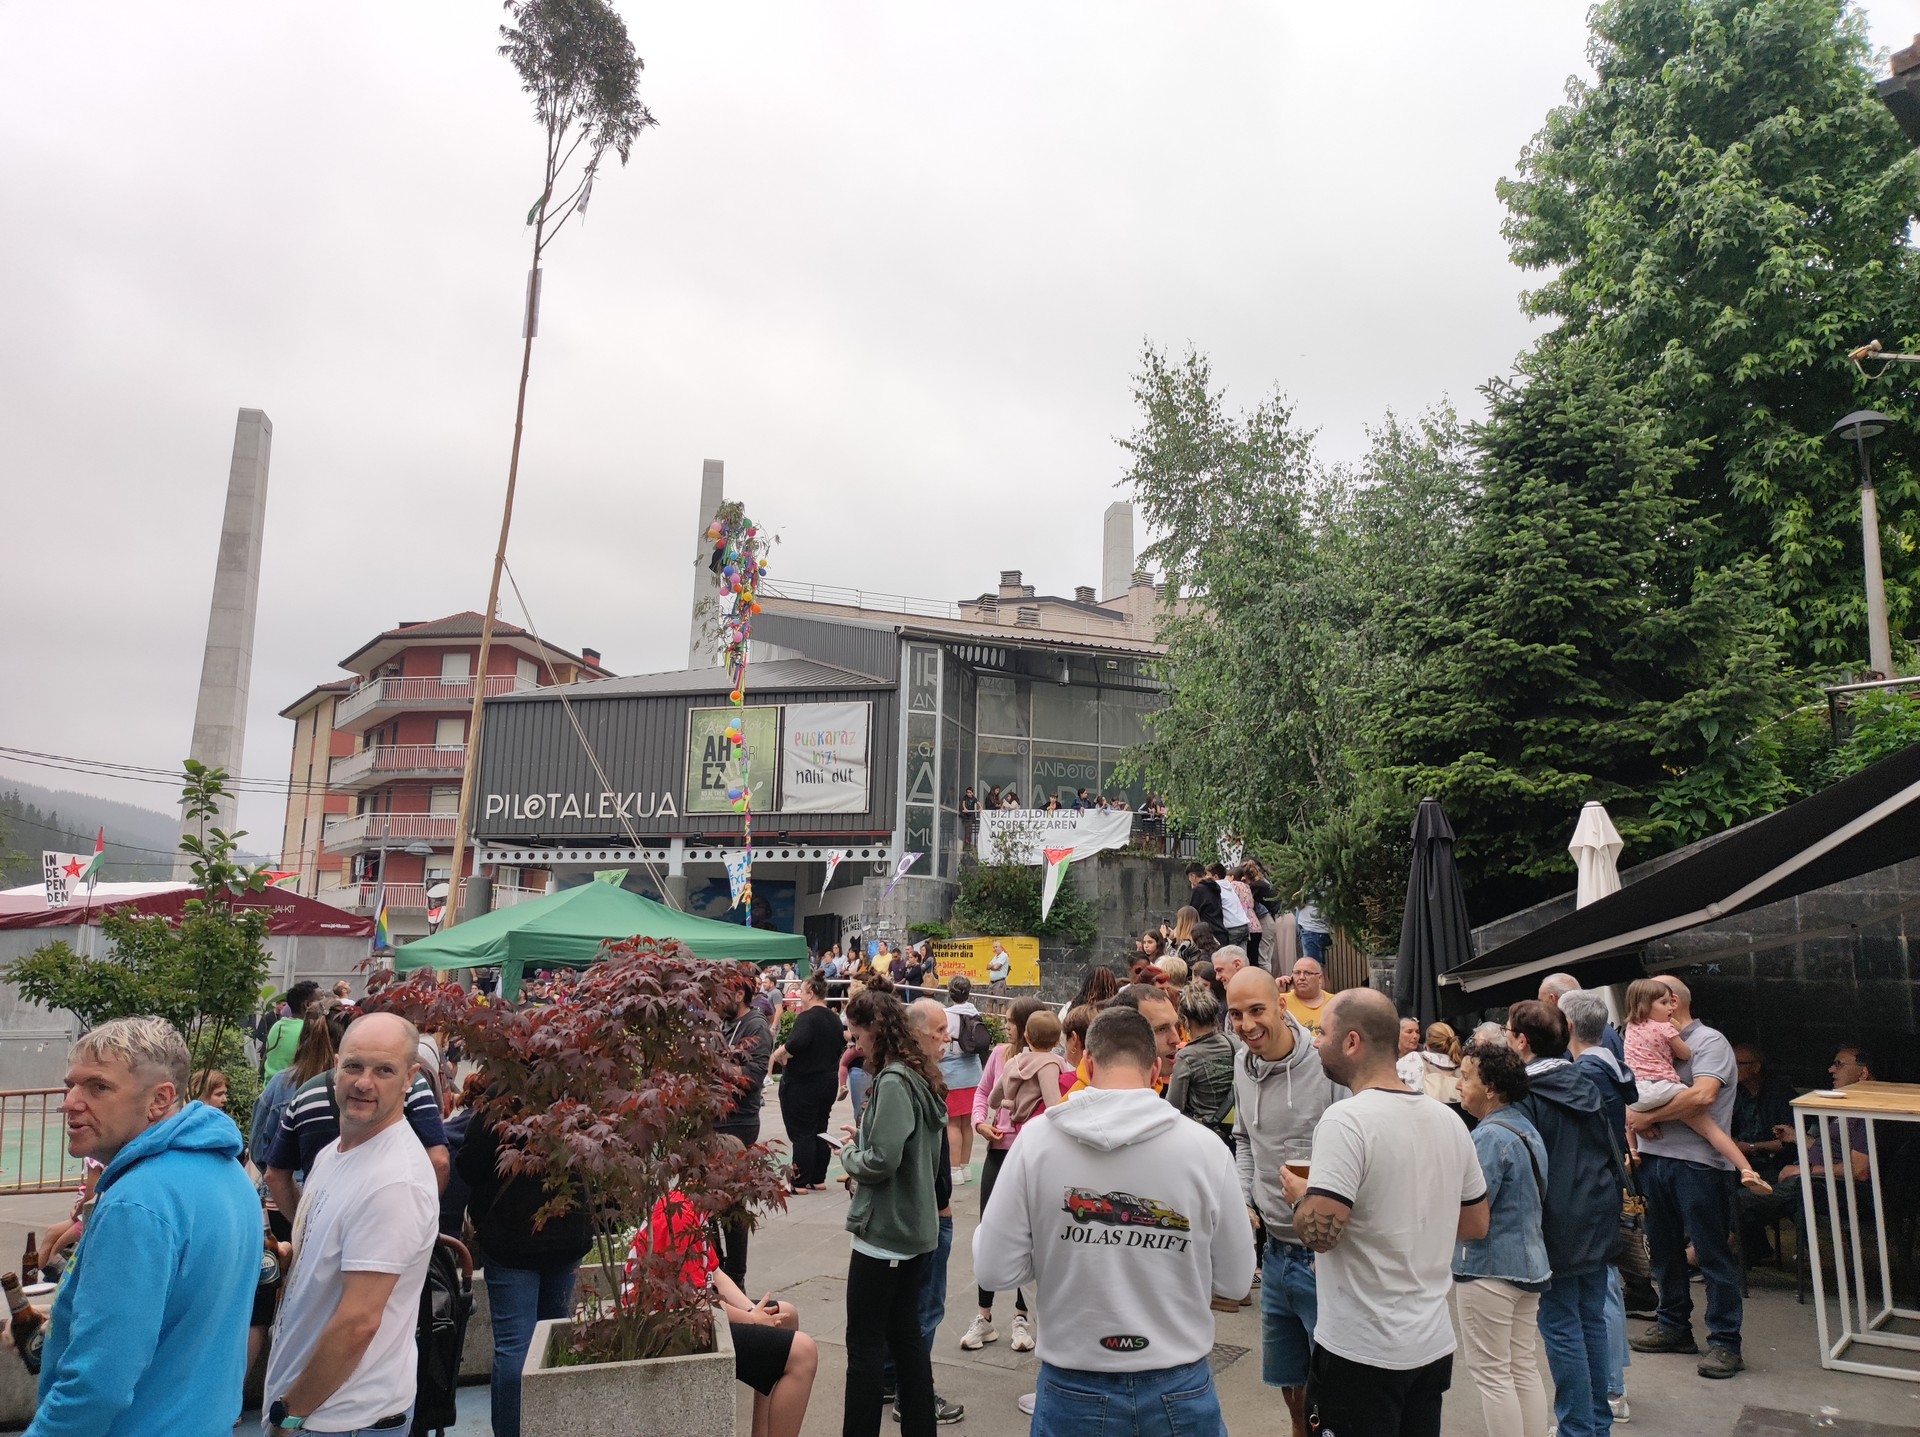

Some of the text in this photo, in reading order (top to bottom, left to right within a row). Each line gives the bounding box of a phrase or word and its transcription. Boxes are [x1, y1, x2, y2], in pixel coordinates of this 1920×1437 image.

[794, 730, 856, 748] euskaraz
[812, 750, 837, 766] bizi
[701, 762, 727, 790] EZ
[795, 767, 854, 785] nahi dut
[1033, 760, 1098, 780] ANBOTO
[485, 791, 679, 820] PILOTALEKUA
[991, 809, 1010, 819] BIZI
[45, 854, 56, 867] IN
[45, 867, 59, 879] DE
[46, 879, 66, 891] PEN
[47, 891, 69, 903] DEN
[273, 904, 296, 914] JAI-KIT
[933, 950, 948, 958] sten
[960, 950, 973, 958] dira
[1061, 1225, 1192, 1252] JOLAS DRIFT
[1105, 1338, 1144, 1348] MMS
